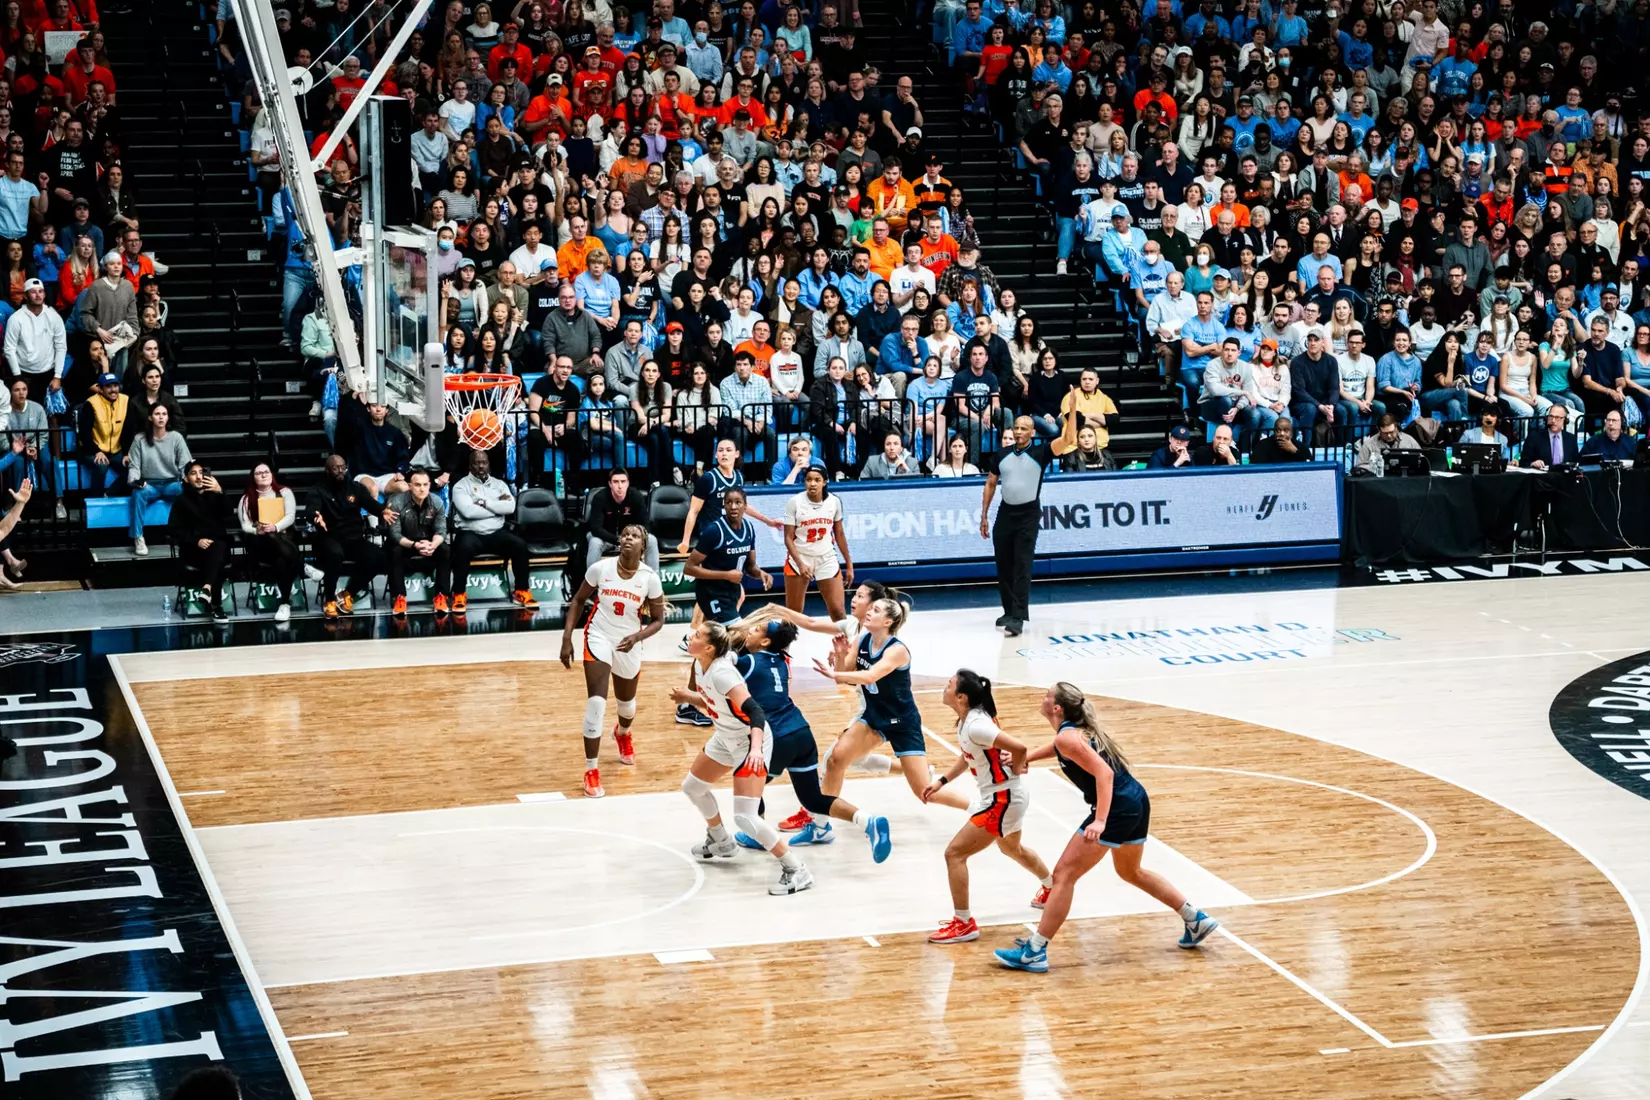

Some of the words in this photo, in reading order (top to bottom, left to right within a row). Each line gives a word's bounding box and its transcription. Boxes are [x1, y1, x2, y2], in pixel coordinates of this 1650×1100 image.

[922, 251, 951, 266] PRINCETON
[1095, 500, 1135, 528] TO
[404, 577, 420, 592] vy
[466, 574, 489, 590] Ivy
[530, 576, 554, 592] Ivy
[660, 569, 683, 586] Ivy
[600, 588, 642, 603] PRINCETON
[613, 601, 625, 616] 3
[709, 599, 722, 614] C
[1047, 623, 1269, 645] JONATHAN
[1159, 648, 1308, 666] COURT
[770, 667, 784, 693] 1
[0, 687, 164, 908] LEAGUE
[0, 928, 226, 1082] IVY
